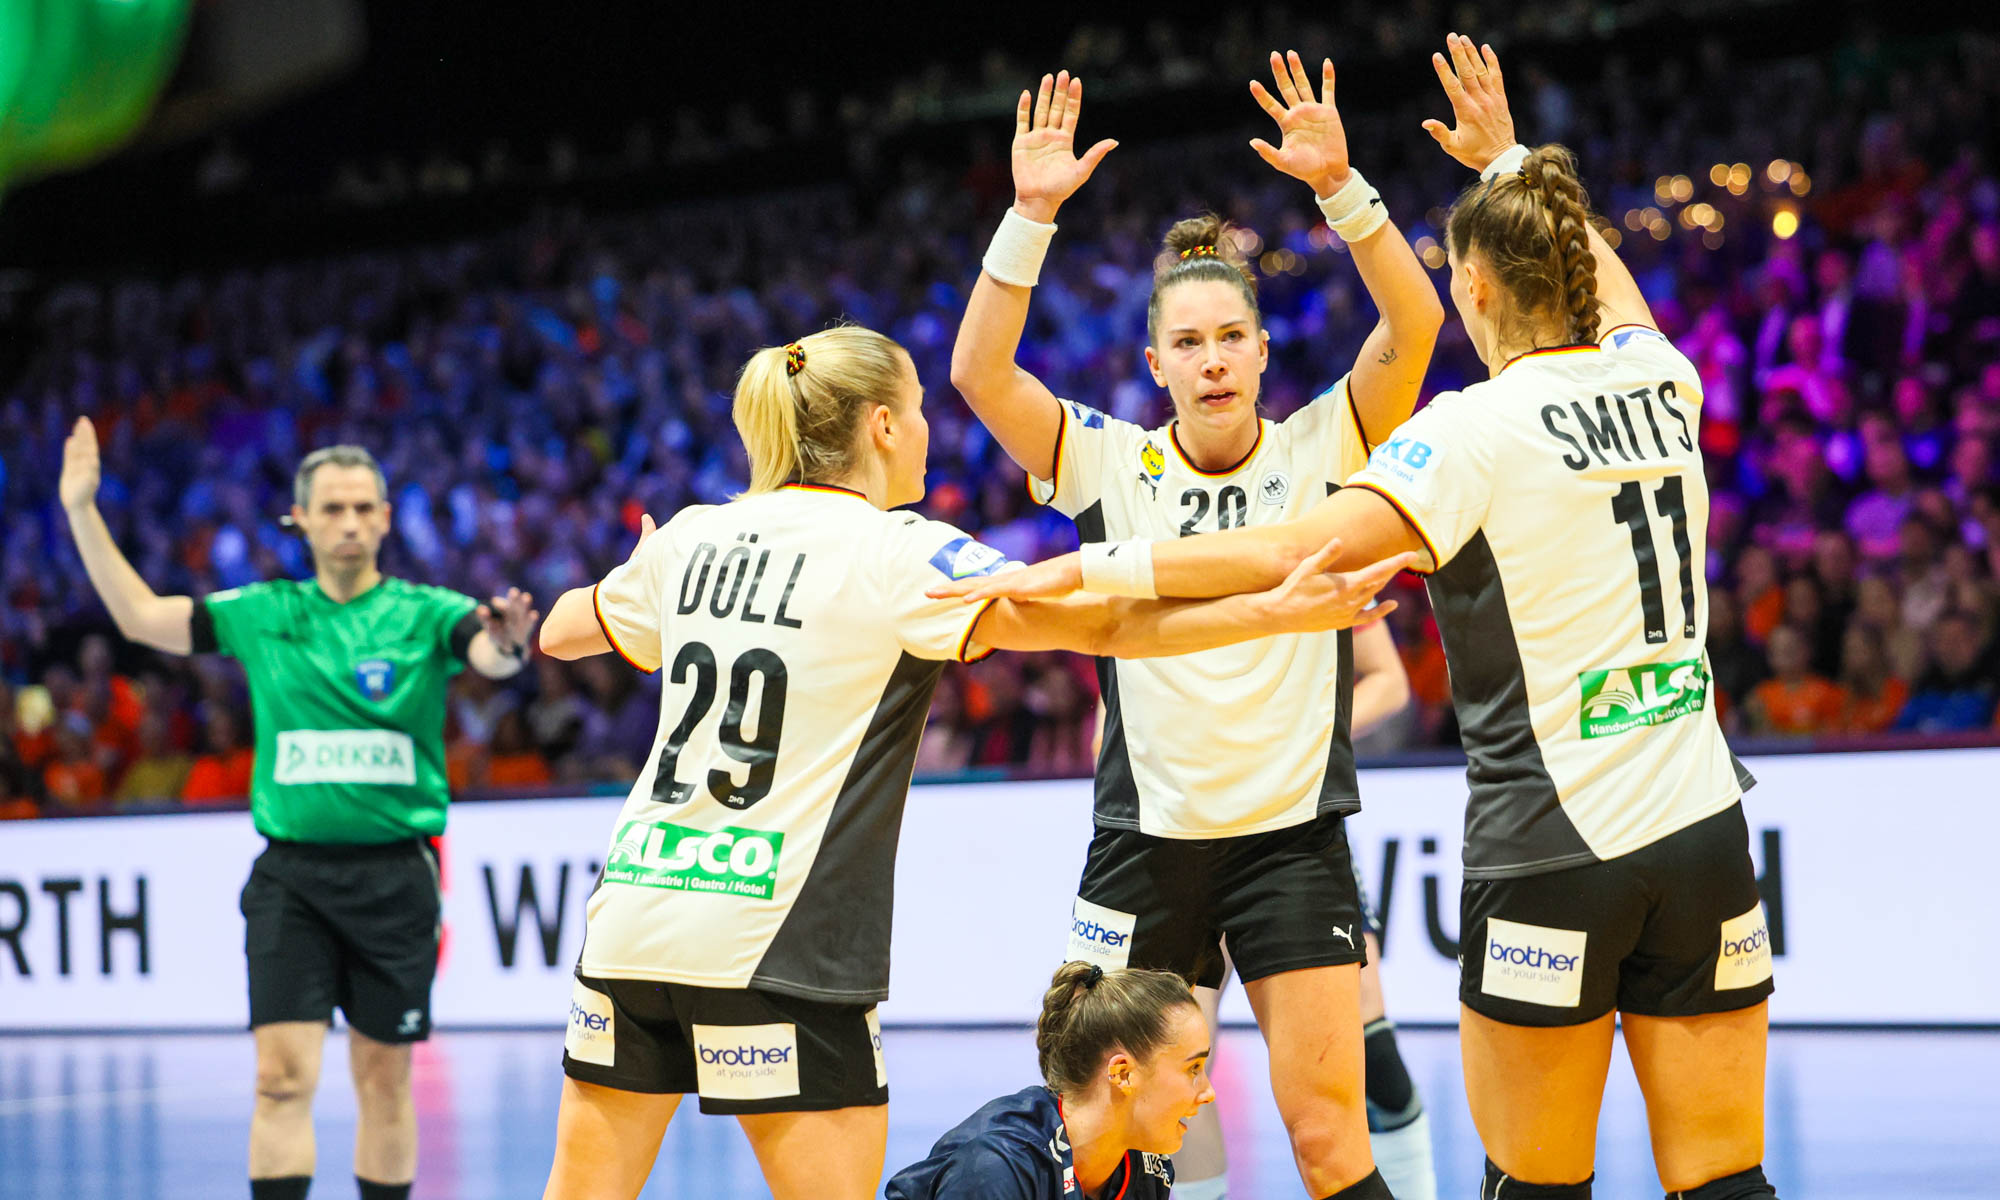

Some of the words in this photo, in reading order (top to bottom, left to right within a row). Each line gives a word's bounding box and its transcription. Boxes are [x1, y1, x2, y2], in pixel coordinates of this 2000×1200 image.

[1540, 380, 1693, 471] SMITS
[1180, 485, 1248, 539] 20
[1611, 475, 1695, 645] 11
[677, 532, 807, 630] DÖLL
[650, 641, 788, 810] 29
[1589, 714, 1648, 736] Handwerk
[316, 743, 406, 768] DEKRA
[690, 877, 728, 891] Gastro
[733, 881, 767, 897] Hotel
[1092, 943, 1112, 956] side
[1490, 938, 1580, 972] brother
[1513, 969, 1537, 980] your
[1539, 973, 1561, 984] side
[699, 1043, 793, 1067] brother
[728, 1069, 753, 1080] your
[754, 1066, 777, 1078] side
